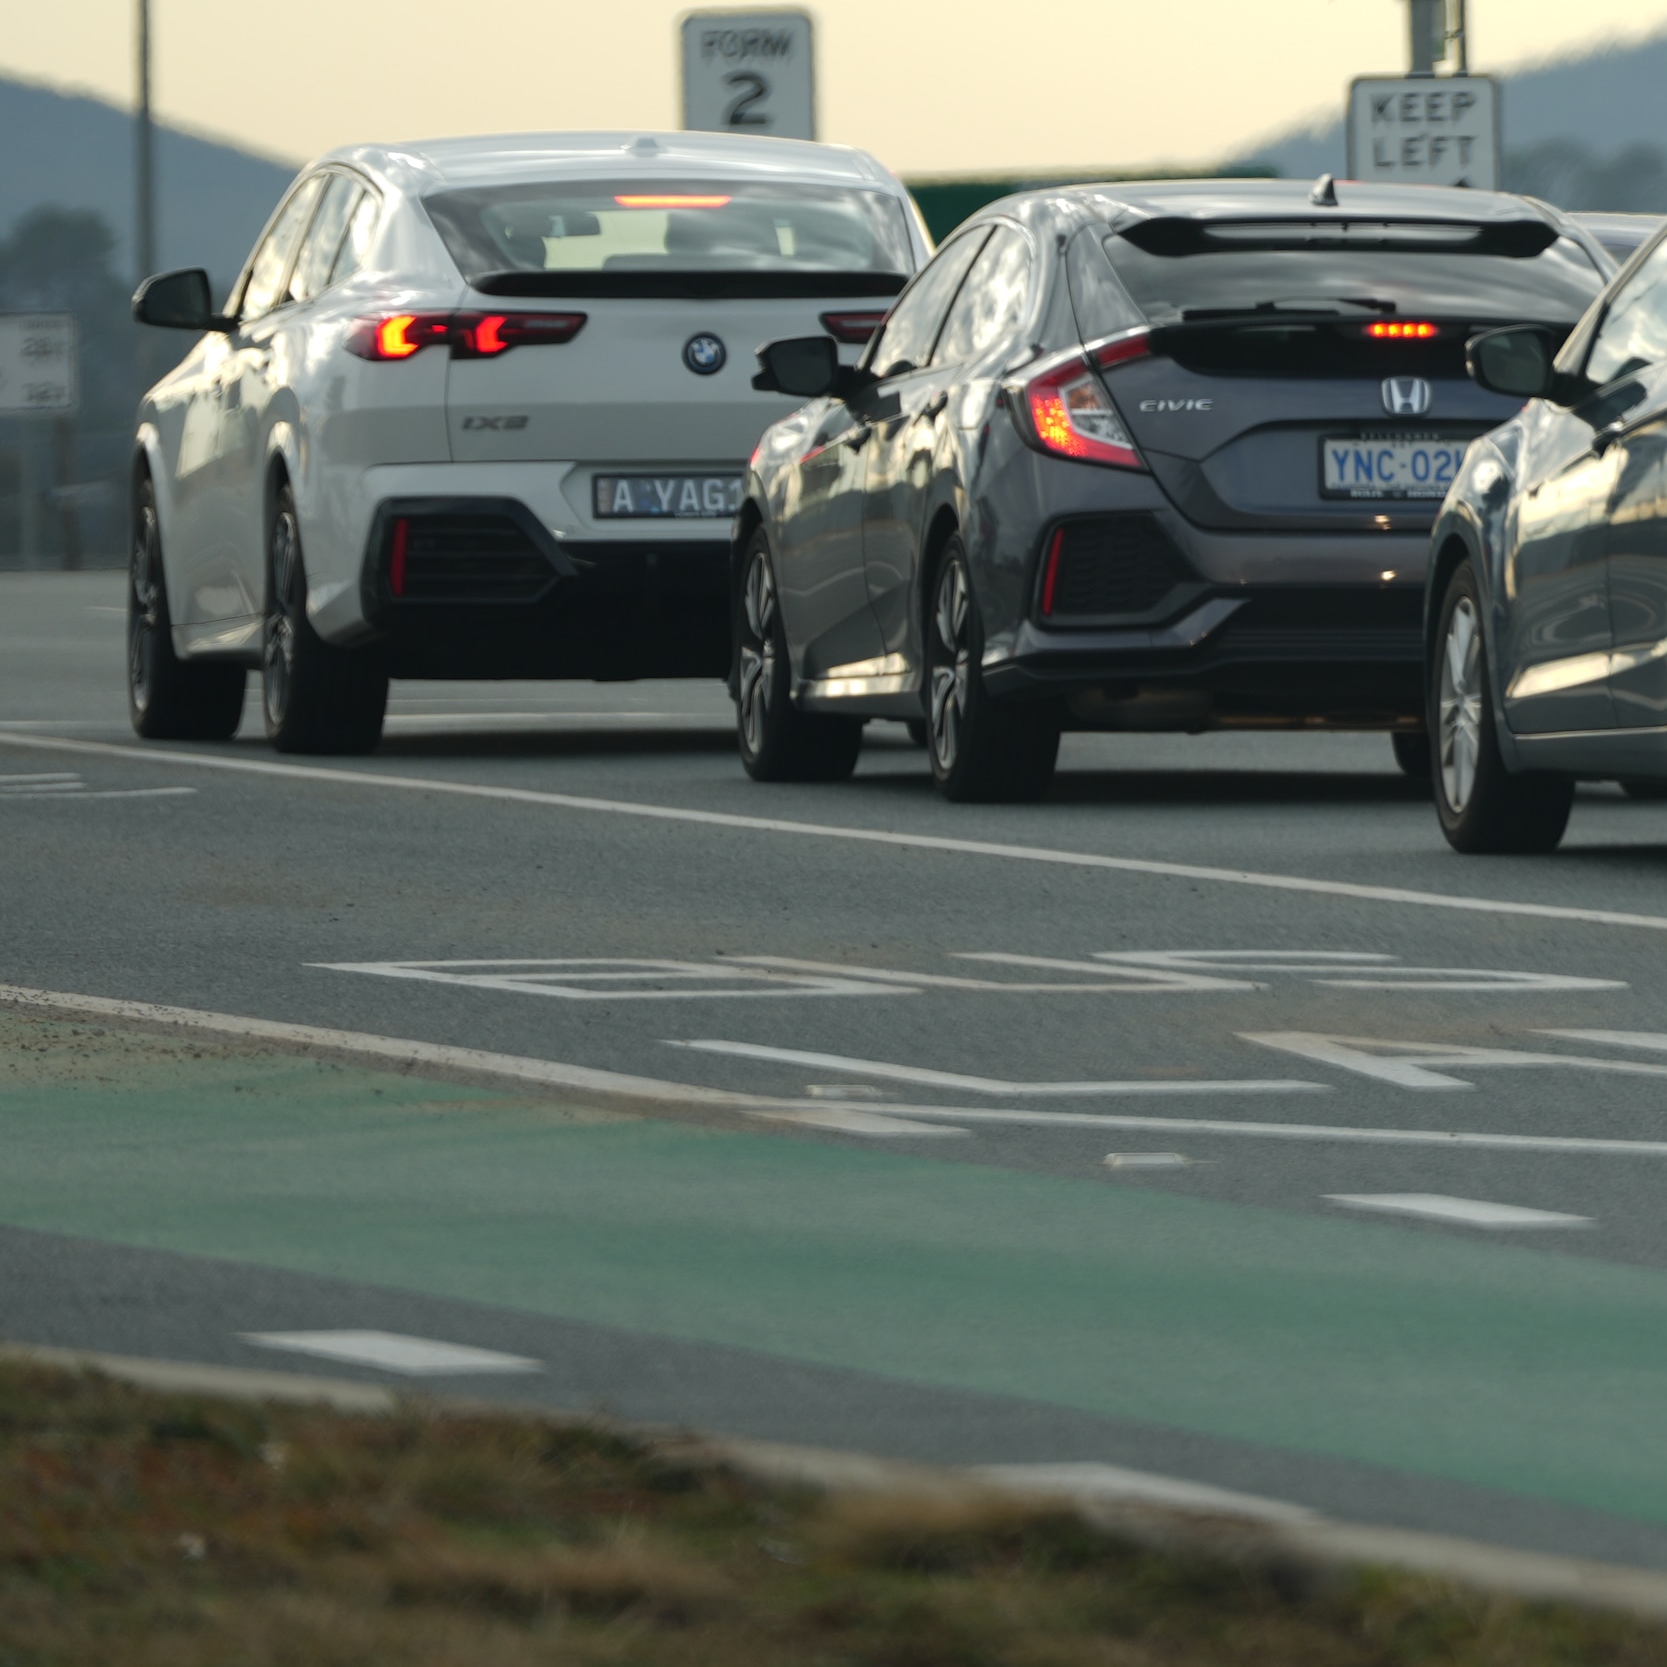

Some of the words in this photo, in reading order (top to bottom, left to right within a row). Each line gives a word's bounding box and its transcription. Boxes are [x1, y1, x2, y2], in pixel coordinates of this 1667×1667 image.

[702, 29, 793, 58] FORM
[723, 71, 773, 126] 2
[1369, 91, 1478, 123] KEEP
[1371, 135, 1476, 167] LEFT
[1139, 398, 1215, 413] CIVIC
